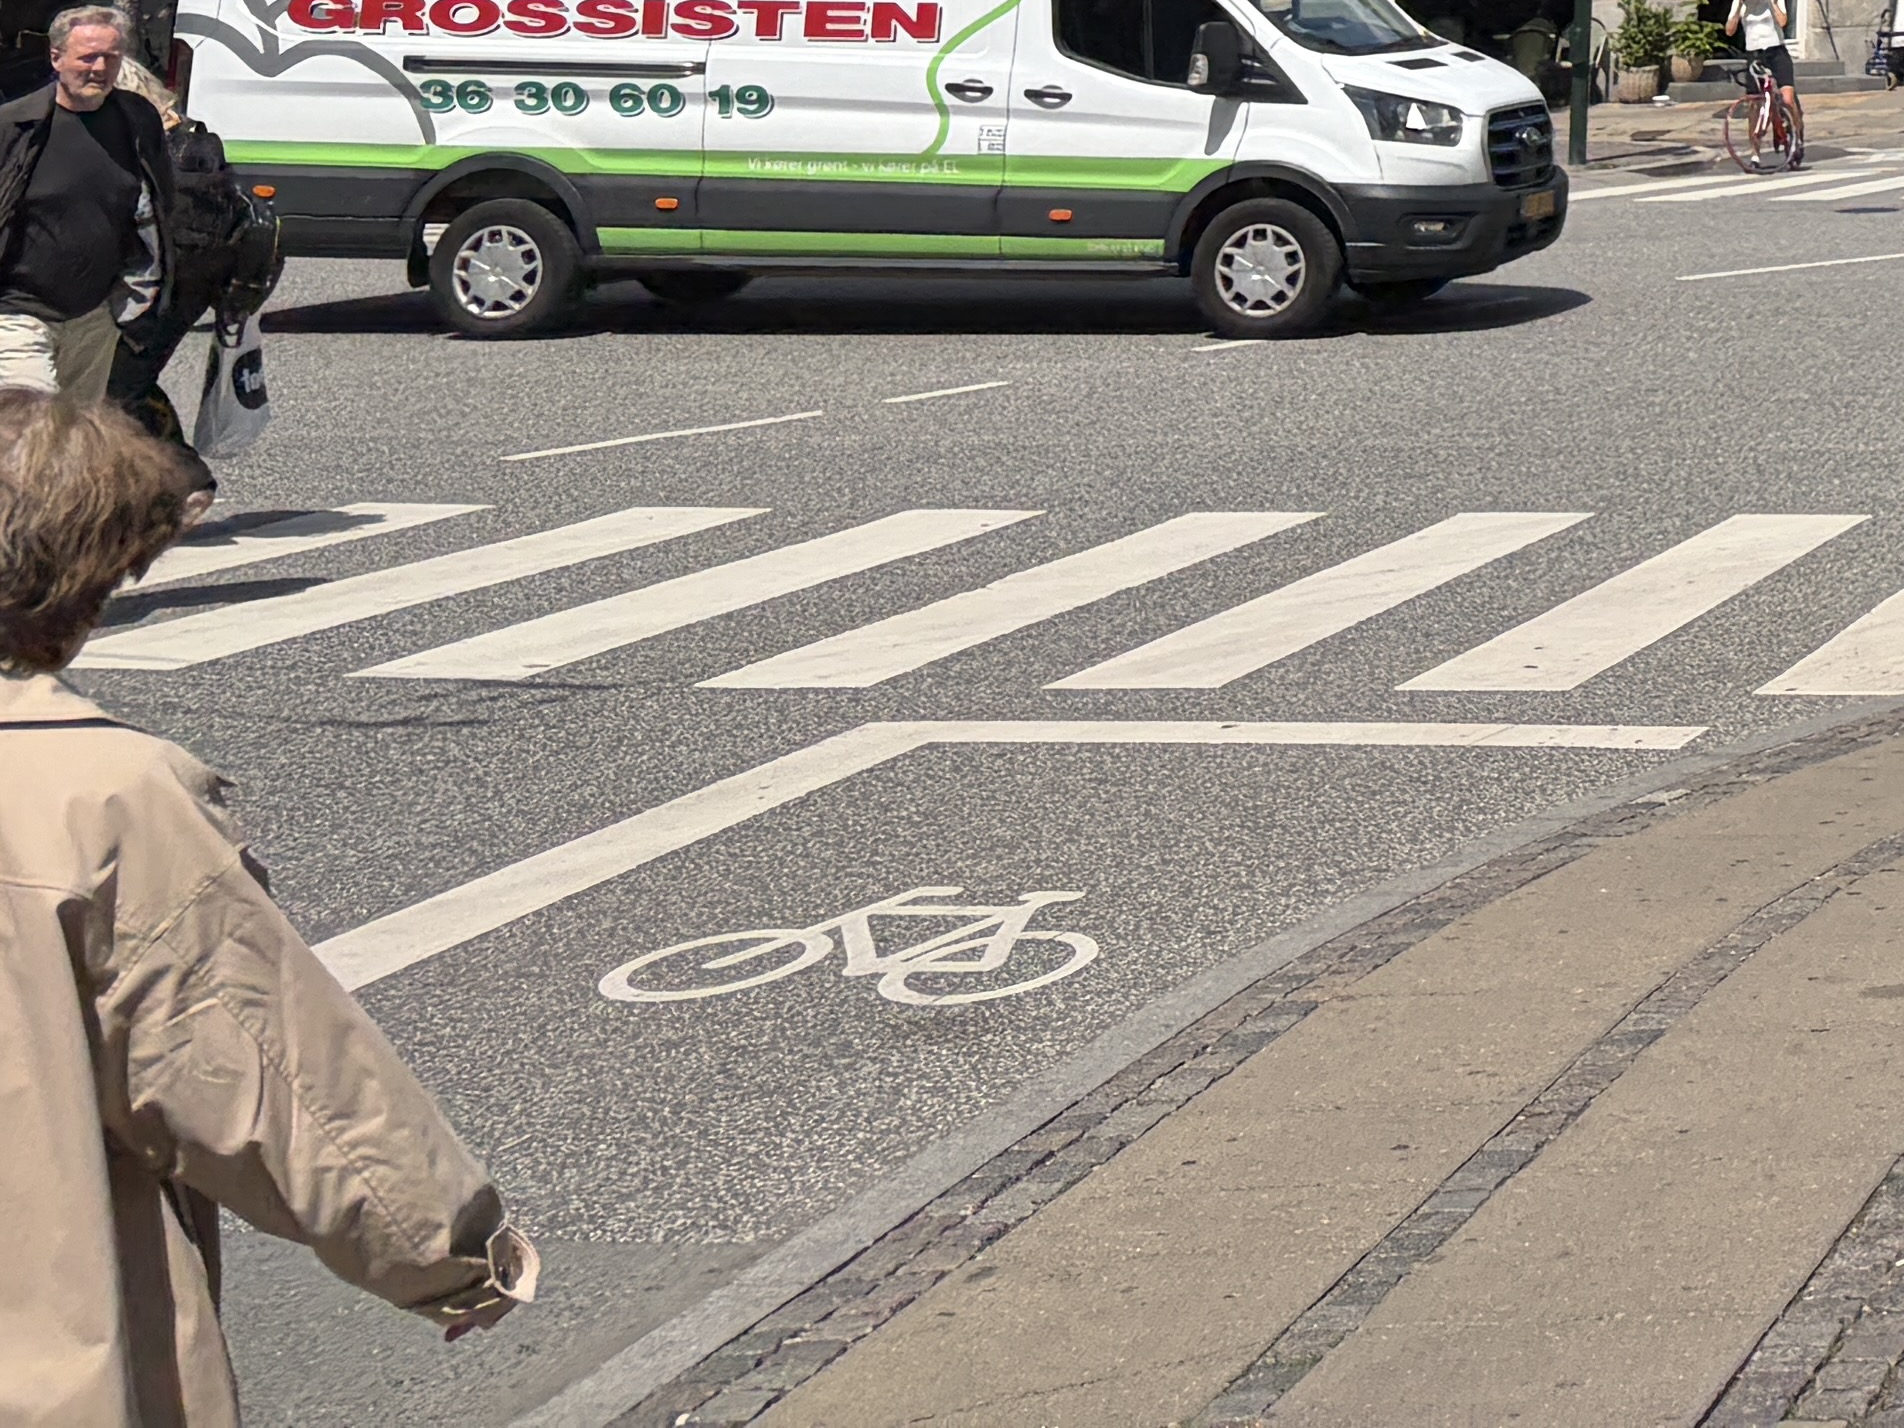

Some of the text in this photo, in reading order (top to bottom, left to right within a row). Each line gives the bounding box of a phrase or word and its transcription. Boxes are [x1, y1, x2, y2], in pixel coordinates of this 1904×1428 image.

[419, 79, 774, 120] 36 30 60 19
